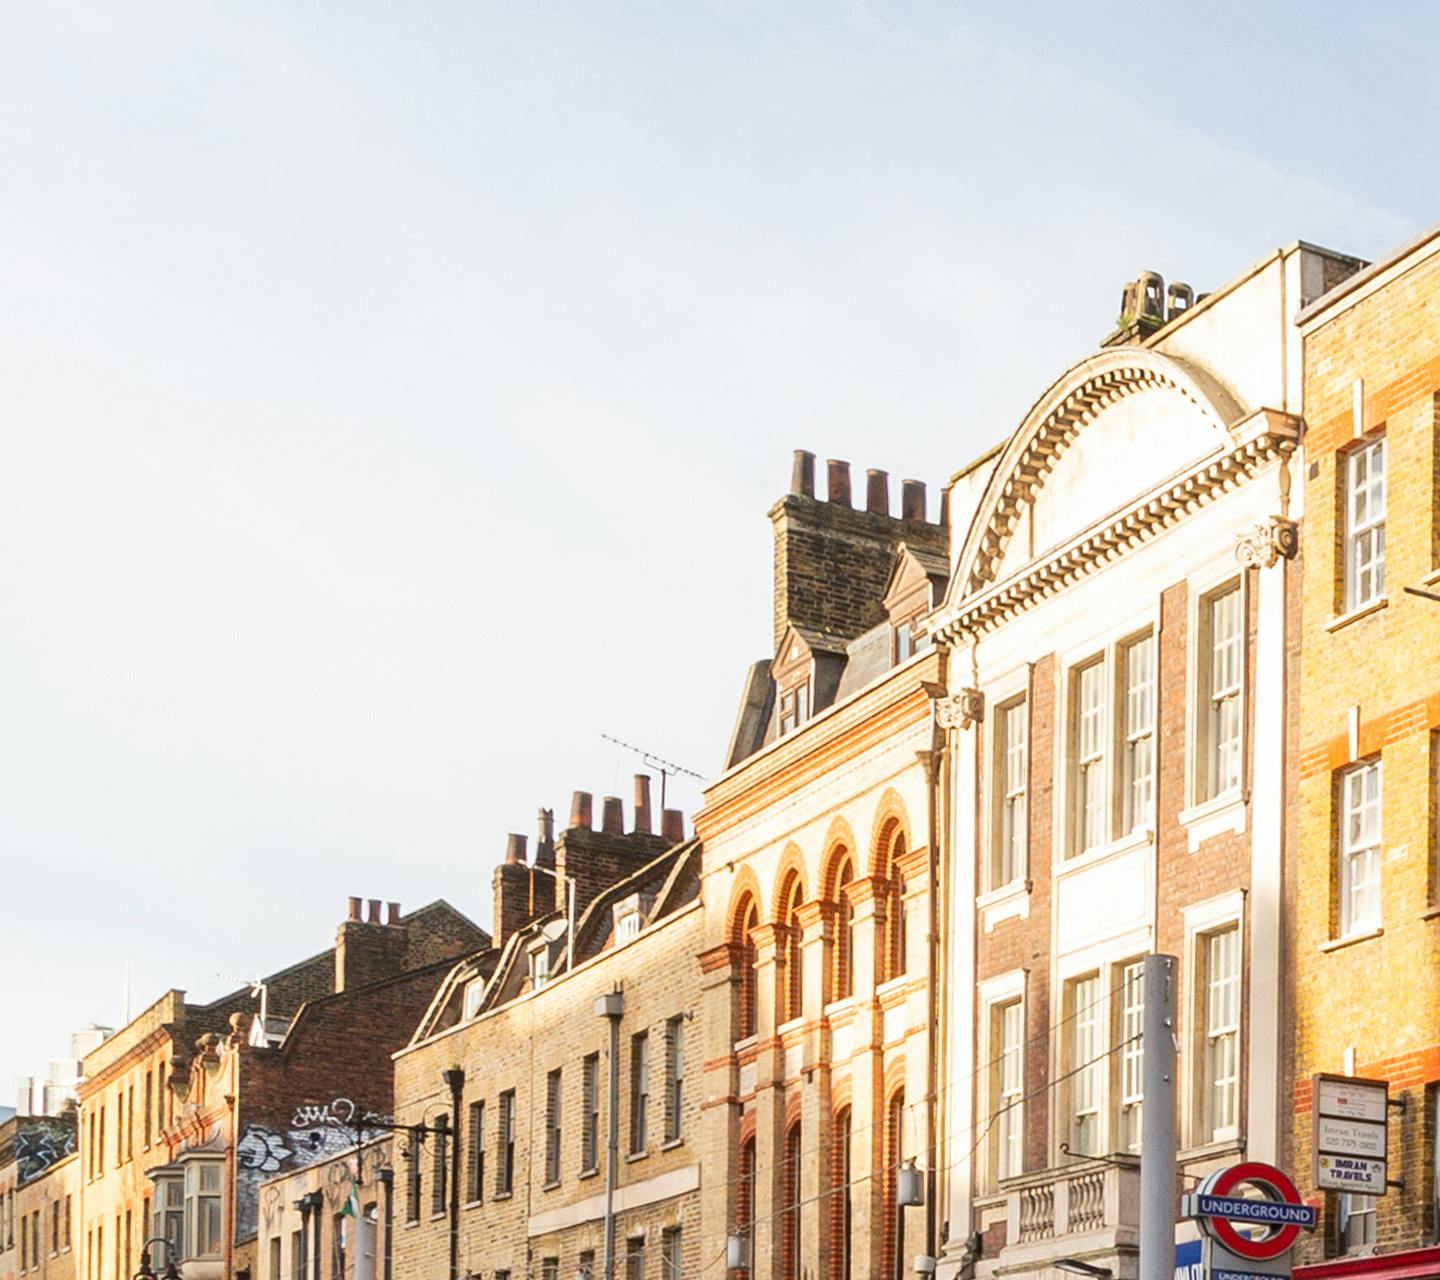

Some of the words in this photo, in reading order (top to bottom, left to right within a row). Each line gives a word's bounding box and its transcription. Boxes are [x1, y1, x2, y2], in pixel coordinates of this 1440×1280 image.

[1335, 1159, 1367, 1171] IMRAN
[1330, 1169, 1372, 1182] TRAVELS
[1201, 1199, 1310, 1222] UNDERGROUND
